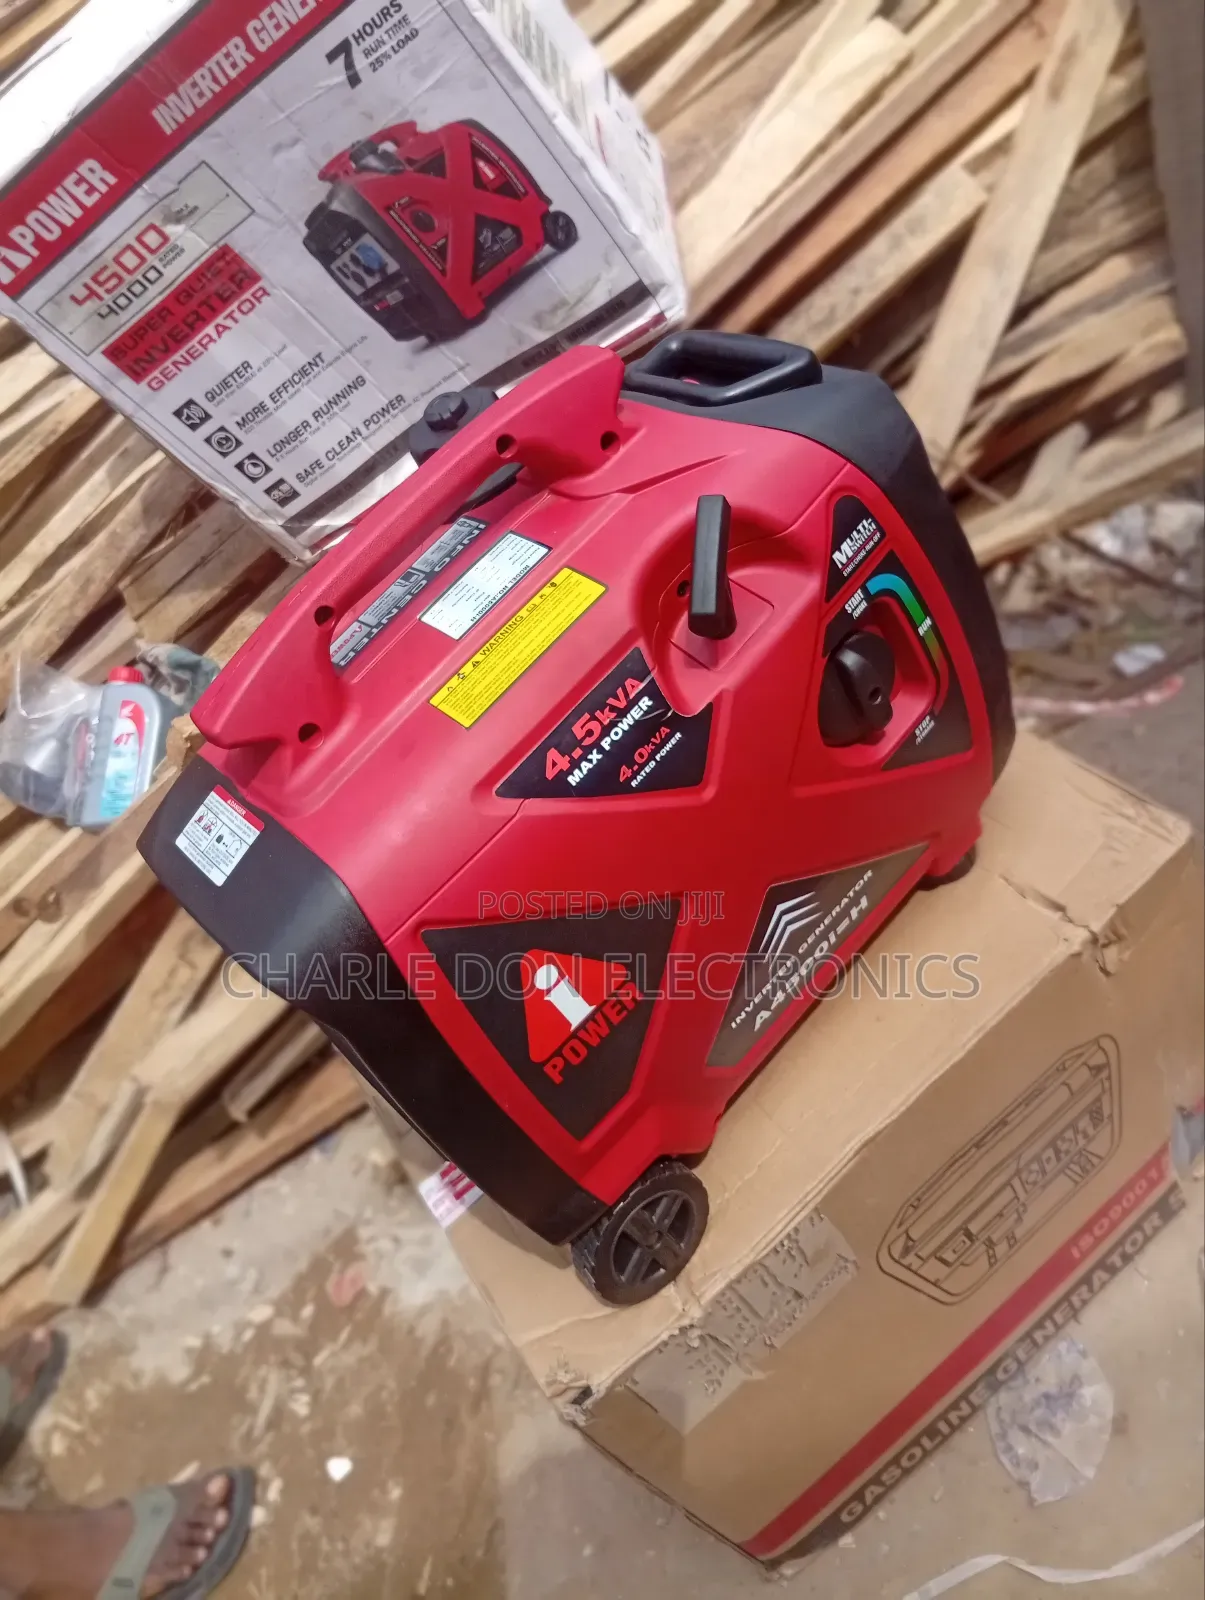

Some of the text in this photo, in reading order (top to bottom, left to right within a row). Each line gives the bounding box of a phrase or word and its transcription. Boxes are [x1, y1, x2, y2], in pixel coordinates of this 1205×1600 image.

[325, 36, 362, 89] 7
[352, 0, 403, 46] HOURS
[362, 13, 412, 60] RUN TIME
[369, 27, 420, 74] 25% LOAD
[151, 36, 255, 136] INVERTER
[8, 158, 118, 258] POWER
[69, 223, 171, 307] 4500
[97, 264, 164, 320] 4000
[158, 243, 180, 263] RATED
[110, 251, 234, 361] SUPER QUIET
[125, 268, 252, 378] INVERTER
[146, 286, 271, 393] GENERATOR
[204, 360, 254, 404] QUIETER
[234, 352, 326, 431] MORE EFFICIENT
[266, 375, 367, 458] LONGER RUNNING
[295, 455, 325, 484] SAFE
[325, 427, 363, 461] CLEAN
[362, 394, 406, 431] POWER
[434, 523, 487, 572] INFO
[849, 522, 877, 553] SWITCH
[338, 580, 427, 667] CENTER
[479, 614, 524, 658] WARNING
[844, 587, 865, 616] START
[917, 615, 933, 637] RUN
[545, 677, 644, 781] 4.5kVA
[567, 695, 654, 787] MAX POWER
[619, 725, 671, 783] 4.0kVA
[630, 731, 683, 788] RATED POWER
[914, 714, 932, 737] STOP
[730, 869, 873, 1030] INVERTER GENERATOR
[543, 982, 644, 1085] POWER
[1070, 1166, 1159, 1260] ISO9001
[839, 1211, 1164, 1524] GASOLINE GENERATOR
